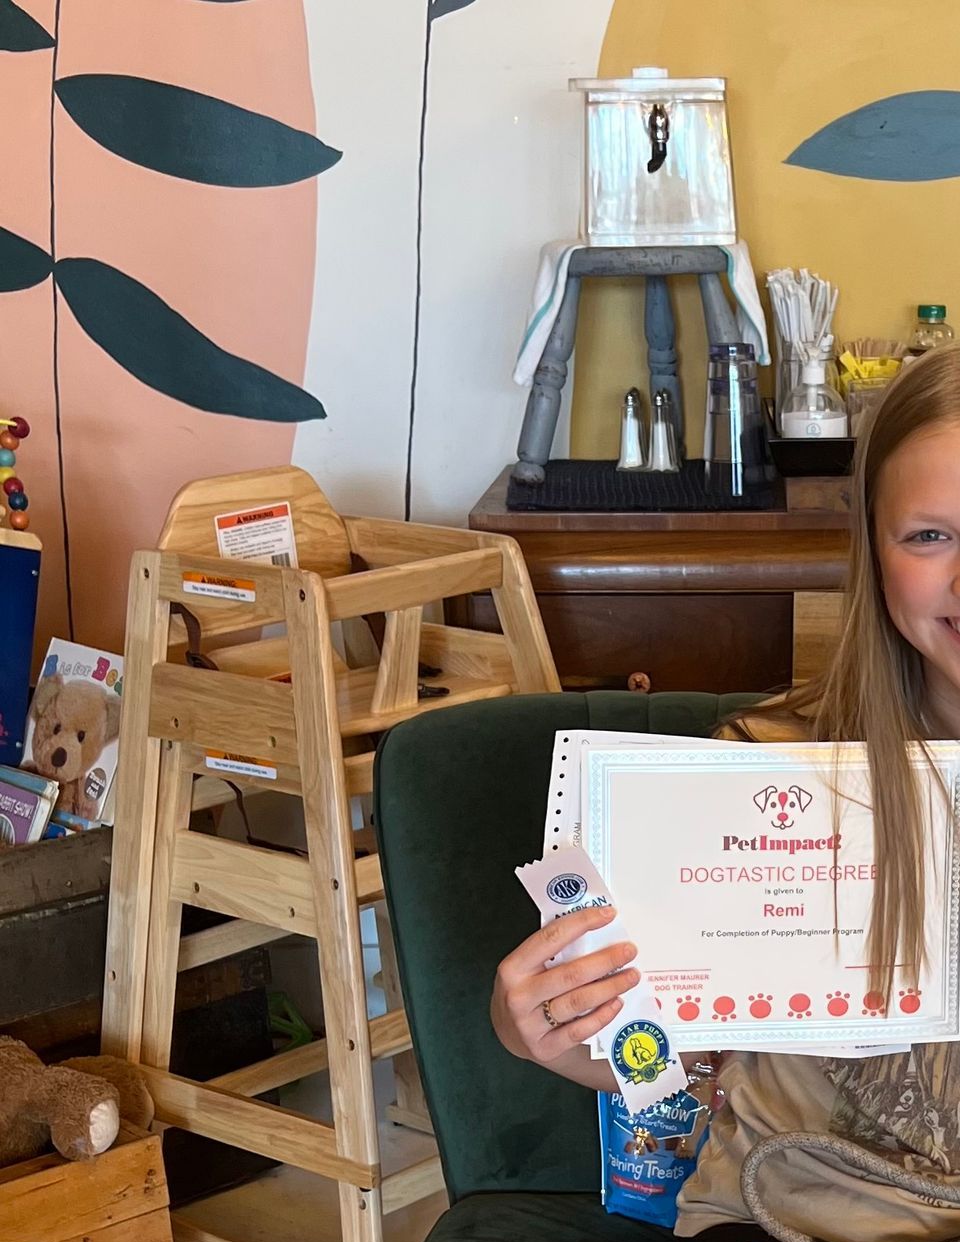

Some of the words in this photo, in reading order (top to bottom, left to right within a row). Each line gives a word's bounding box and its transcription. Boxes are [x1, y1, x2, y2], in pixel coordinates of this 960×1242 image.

[680, 866, 795, 883] DOGTASTIC
[765, 887, 771, 895] is
[773, 887, 795, 897] given
[796, 886, 804, 895] to
[763, 903, 805, 917] Remi
[701, 930, 714, 938] For
[716, 929, 759, 938] Completion
[761, 929, 770, 937] of
[833, 928, 864, 937] Program
[654, 984, 671, 992] DOG
[672, 983, 704, 991] TRAINER
[617, 1023, 640, 1043] STAR
[643, 1023, 665, 1044] PUPPY
[644, 1160, 685, 1180] Treats
